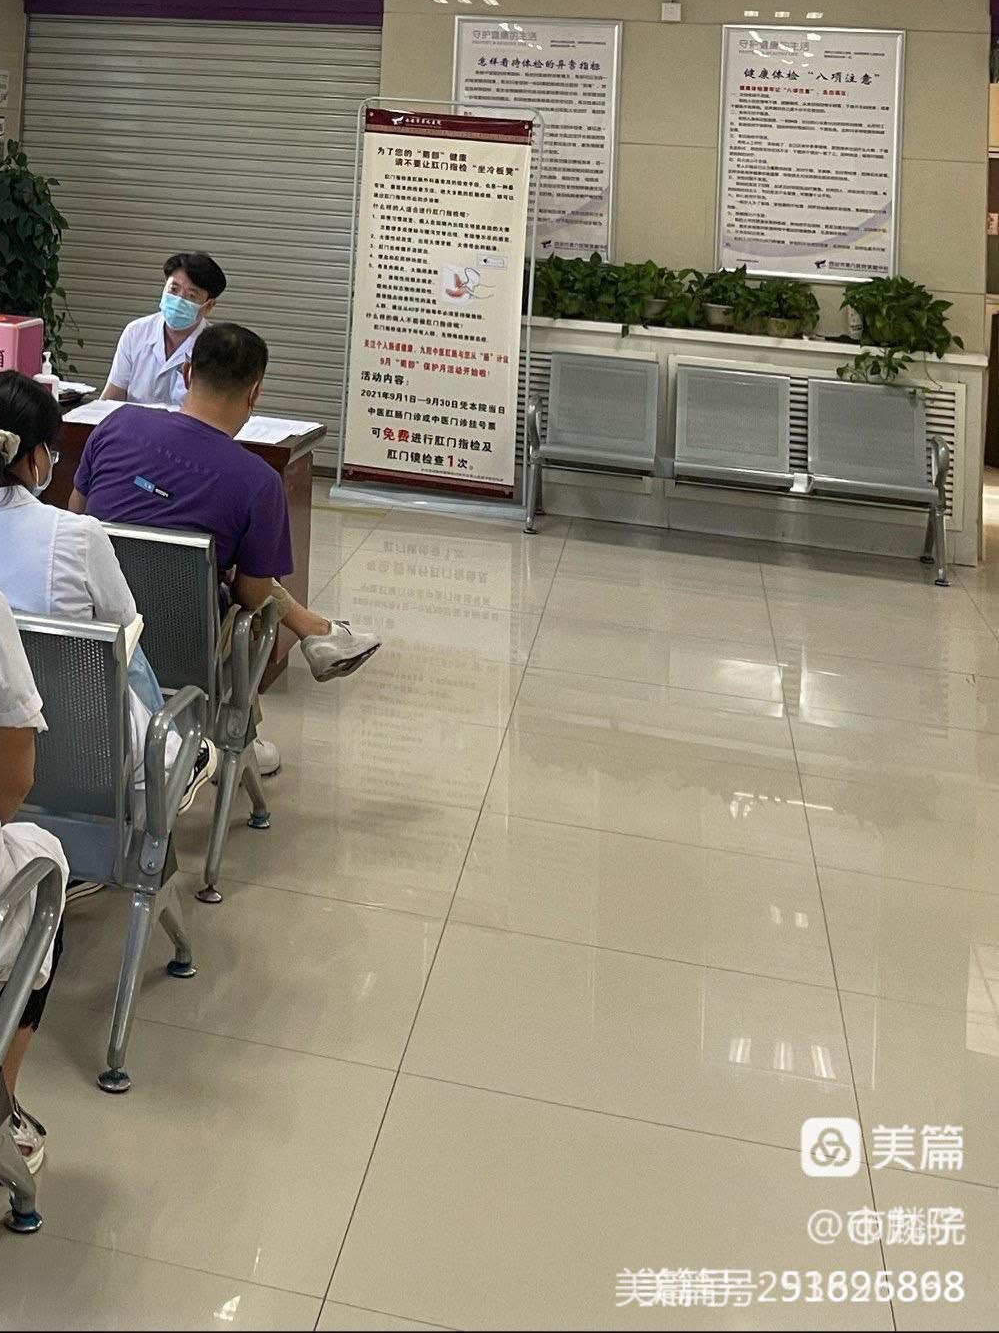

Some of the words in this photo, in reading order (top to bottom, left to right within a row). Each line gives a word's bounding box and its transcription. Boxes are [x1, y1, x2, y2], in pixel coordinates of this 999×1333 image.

[371, 426, 493, 453] 可免费进行肛门指检及
